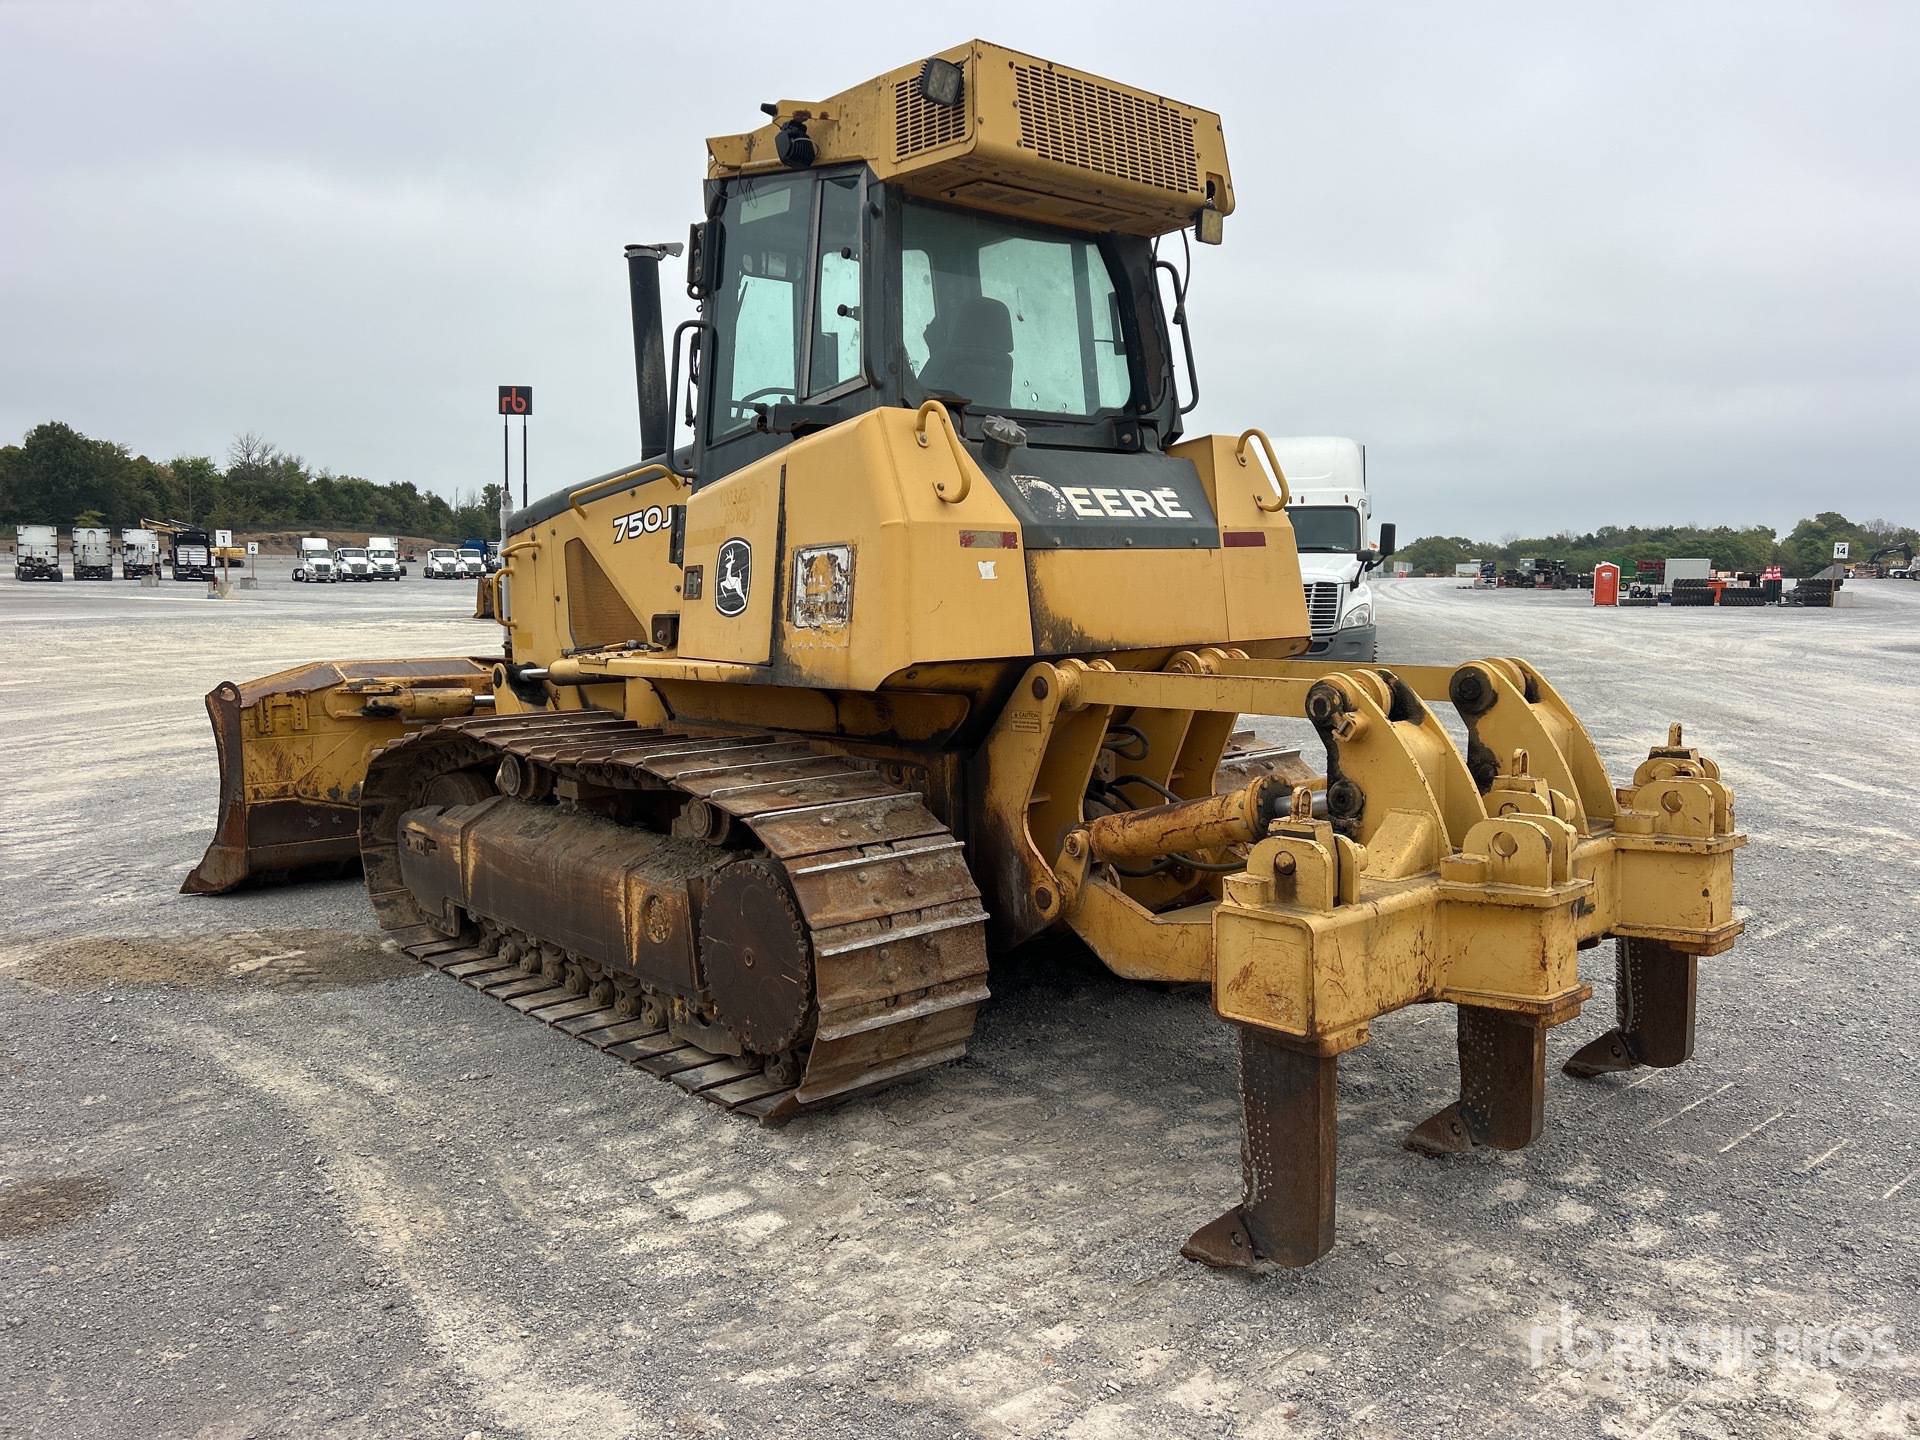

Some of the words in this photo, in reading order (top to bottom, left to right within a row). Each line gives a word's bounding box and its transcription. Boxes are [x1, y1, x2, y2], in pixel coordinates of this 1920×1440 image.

[501, 387, 527, 413] rb
[613, 504, 672, 545] 750J
[221, 535, 226, 543] 1
[1836, 547, 1846, 555] 14
